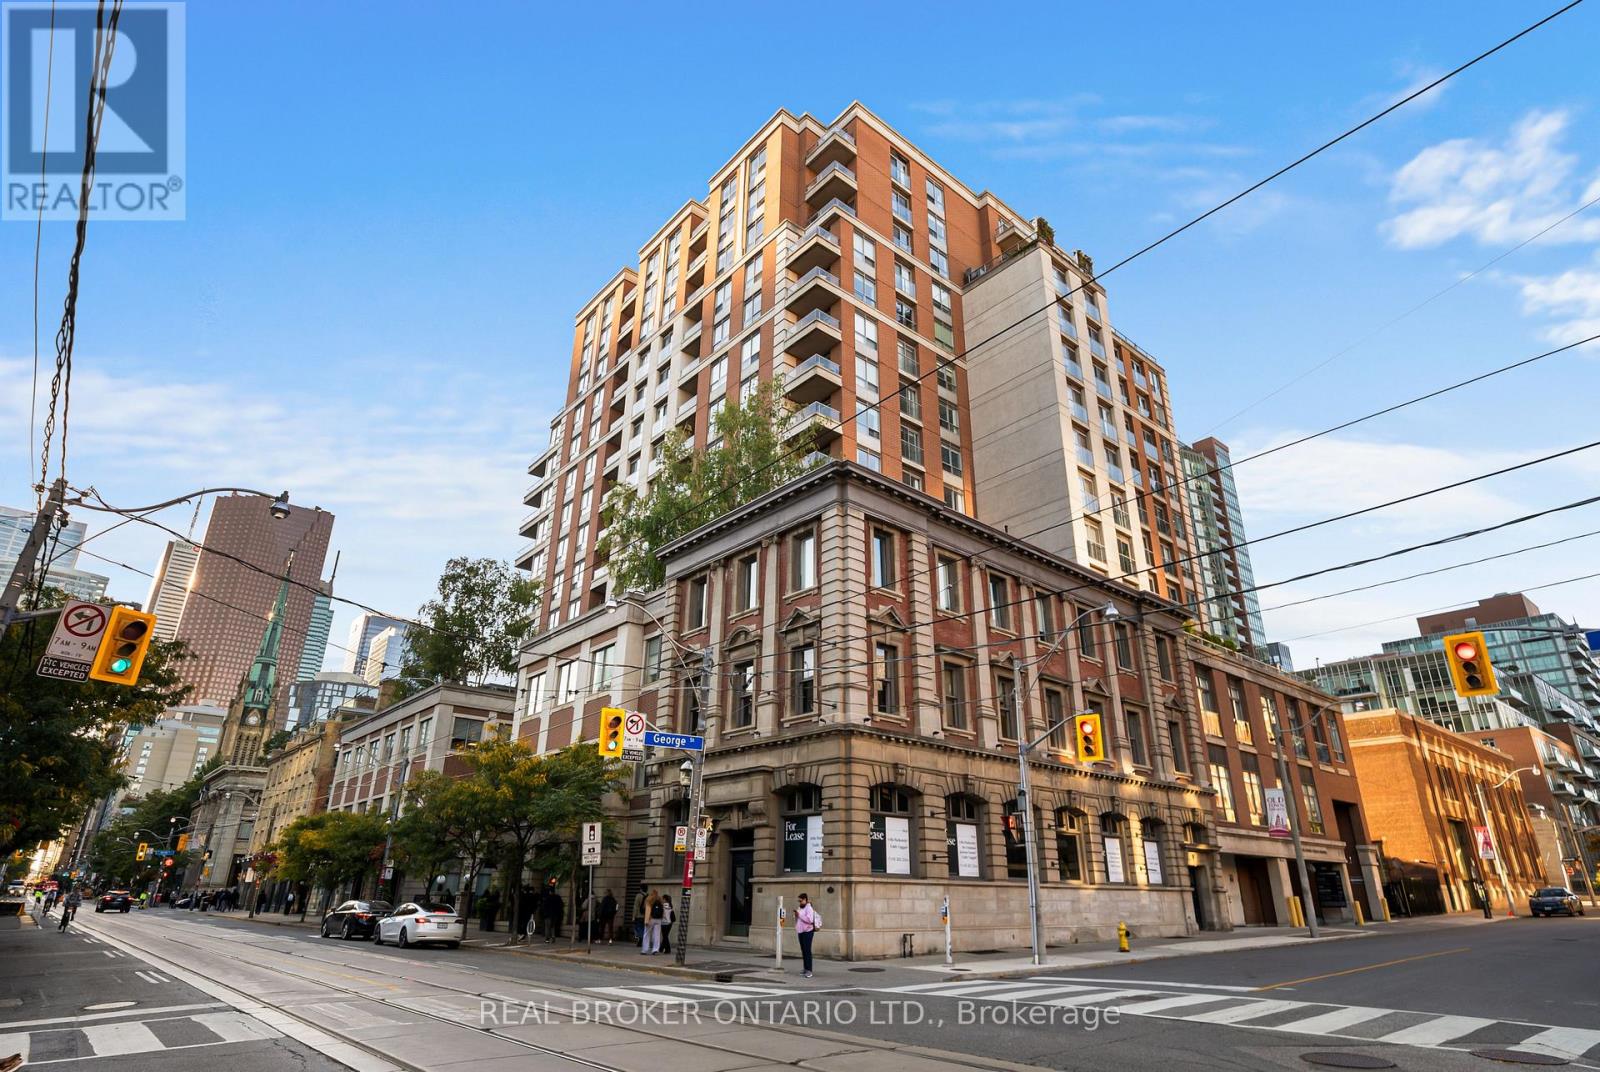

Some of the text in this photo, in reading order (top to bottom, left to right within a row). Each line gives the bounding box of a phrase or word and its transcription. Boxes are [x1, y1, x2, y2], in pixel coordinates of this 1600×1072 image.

[43, 658, 91, 672] TTC VEHICLES
[41, 666, 86, 679] EXCEPTED
[653, 733, 686, 748] George
[785, 821, 797, 831] For
[785, 831, 805, 841] Lease
